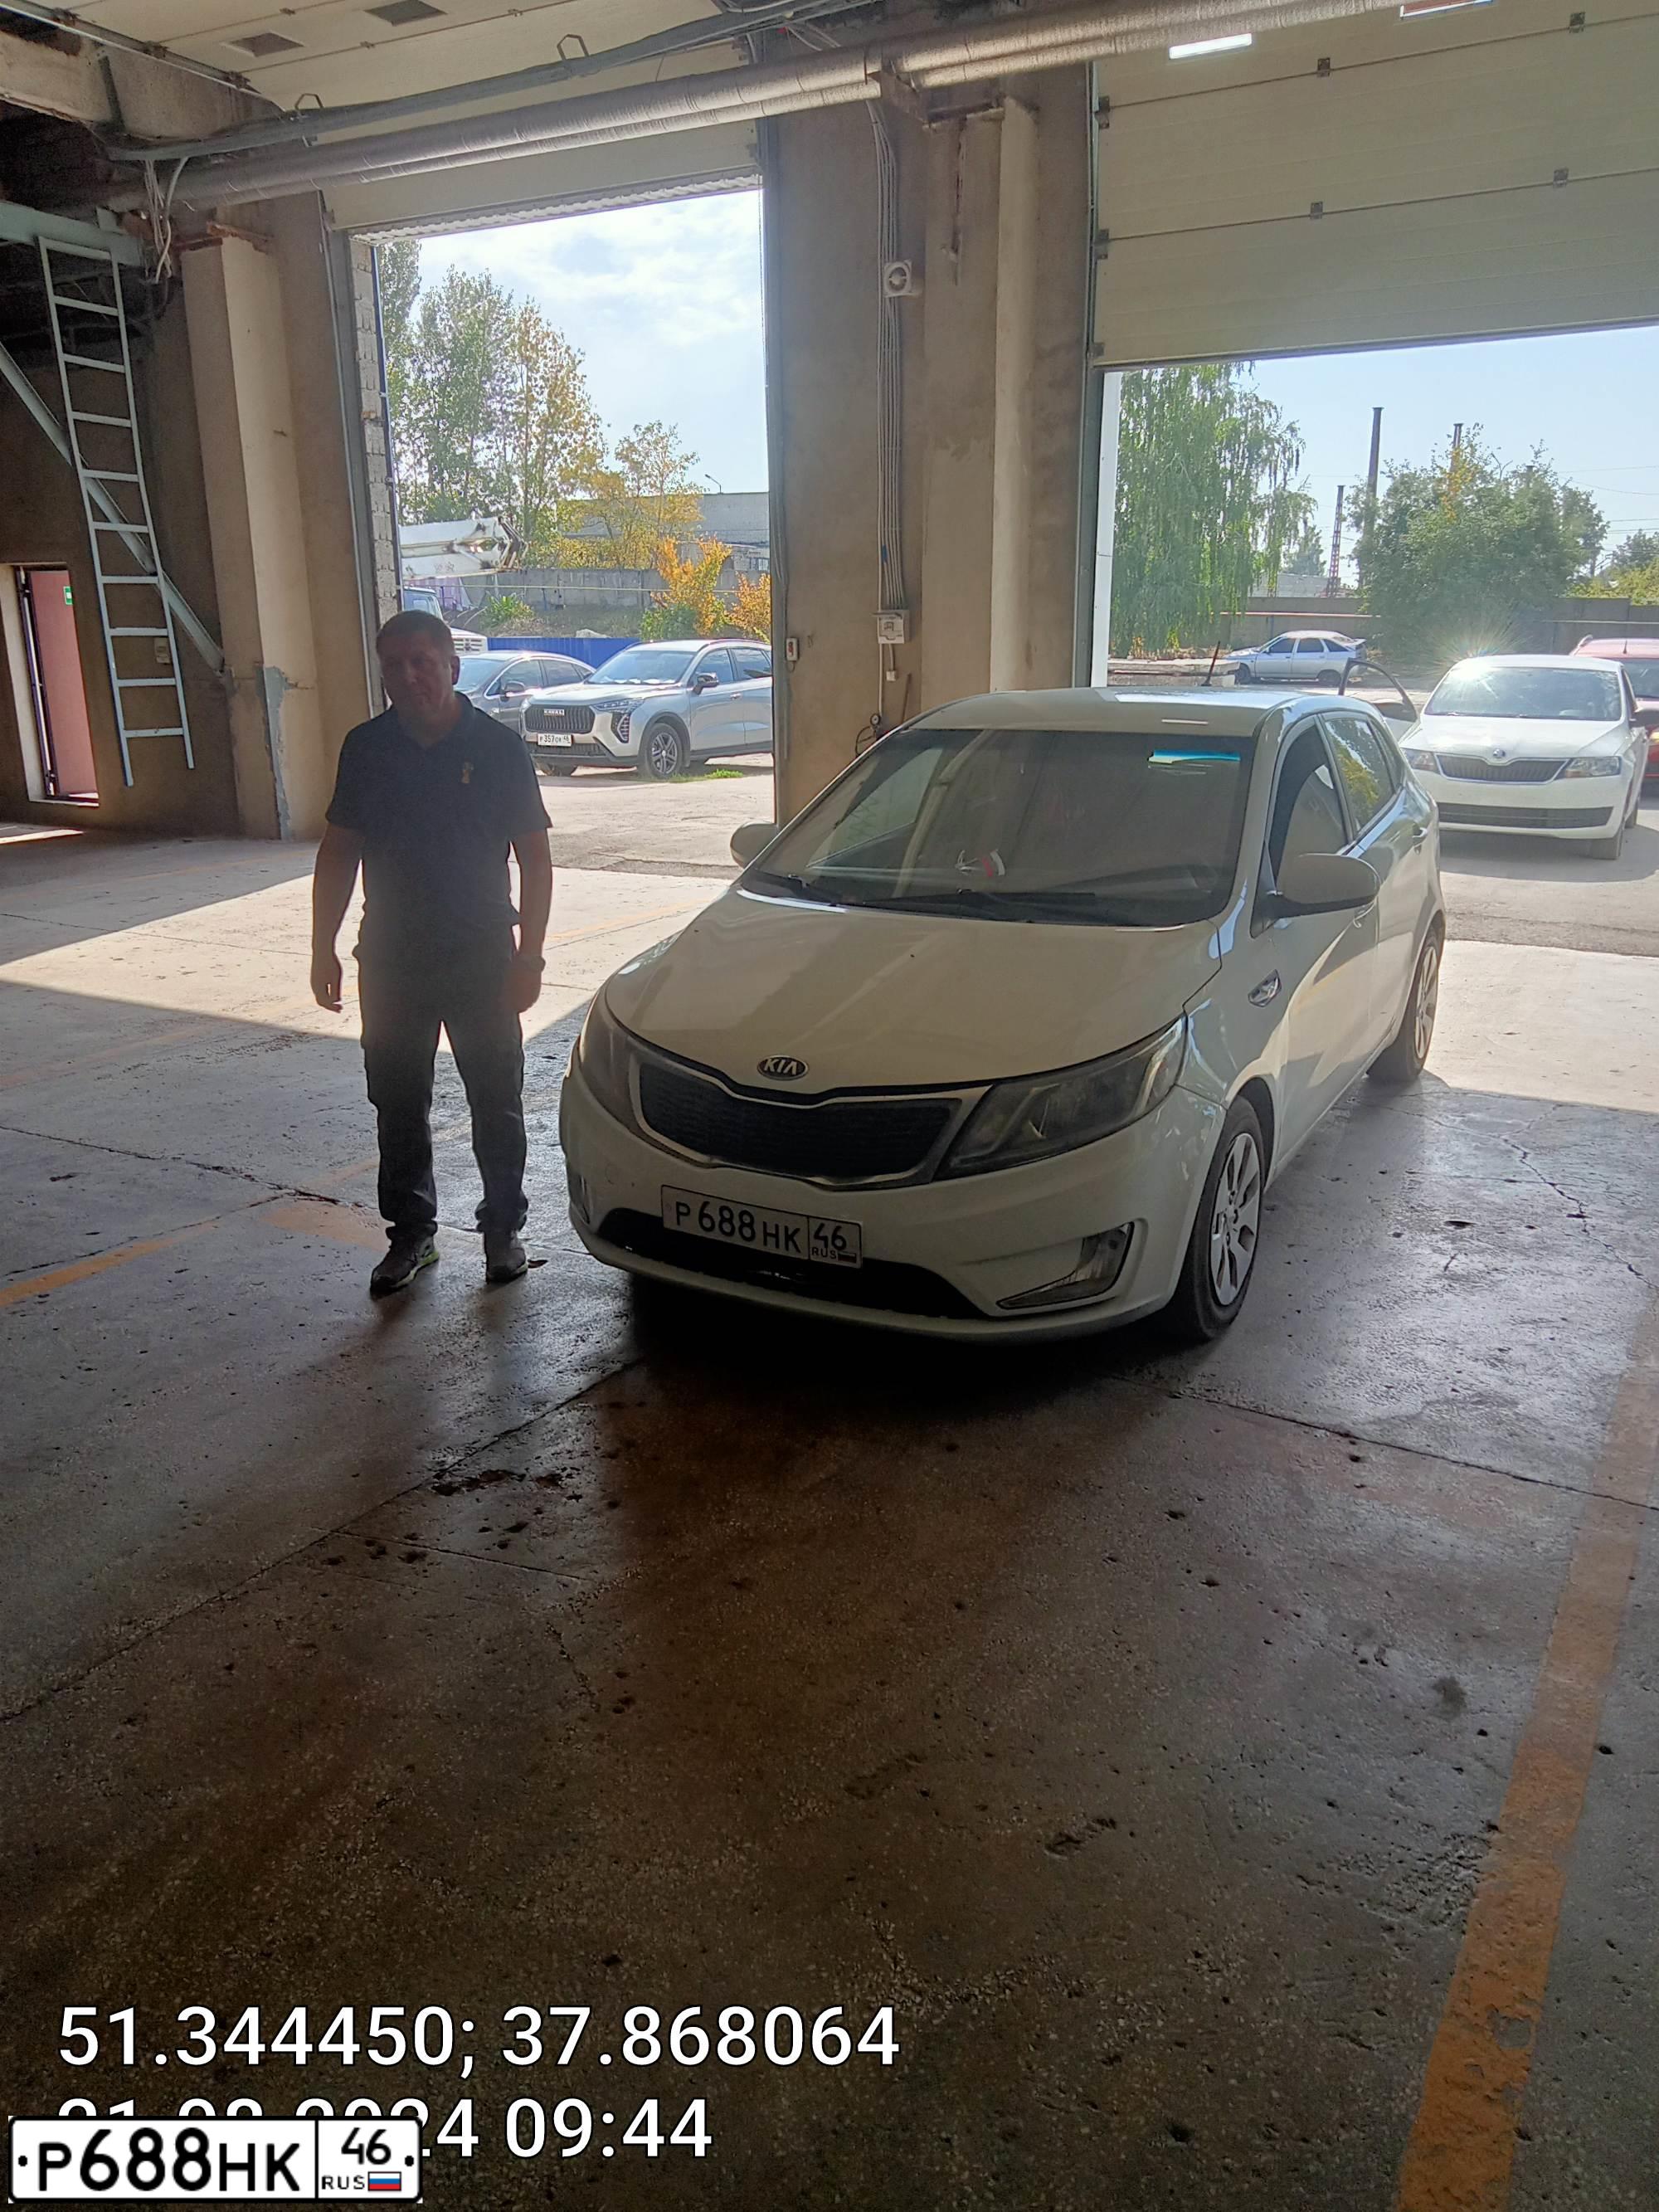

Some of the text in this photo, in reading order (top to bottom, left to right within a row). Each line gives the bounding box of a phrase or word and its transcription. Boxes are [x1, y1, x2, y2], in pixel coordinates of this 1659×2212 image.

[764, 1059, 797, 1075] KIA
[813, 1222, 847, 1251] 46
[811, 1246, 837, 1259] RUS
